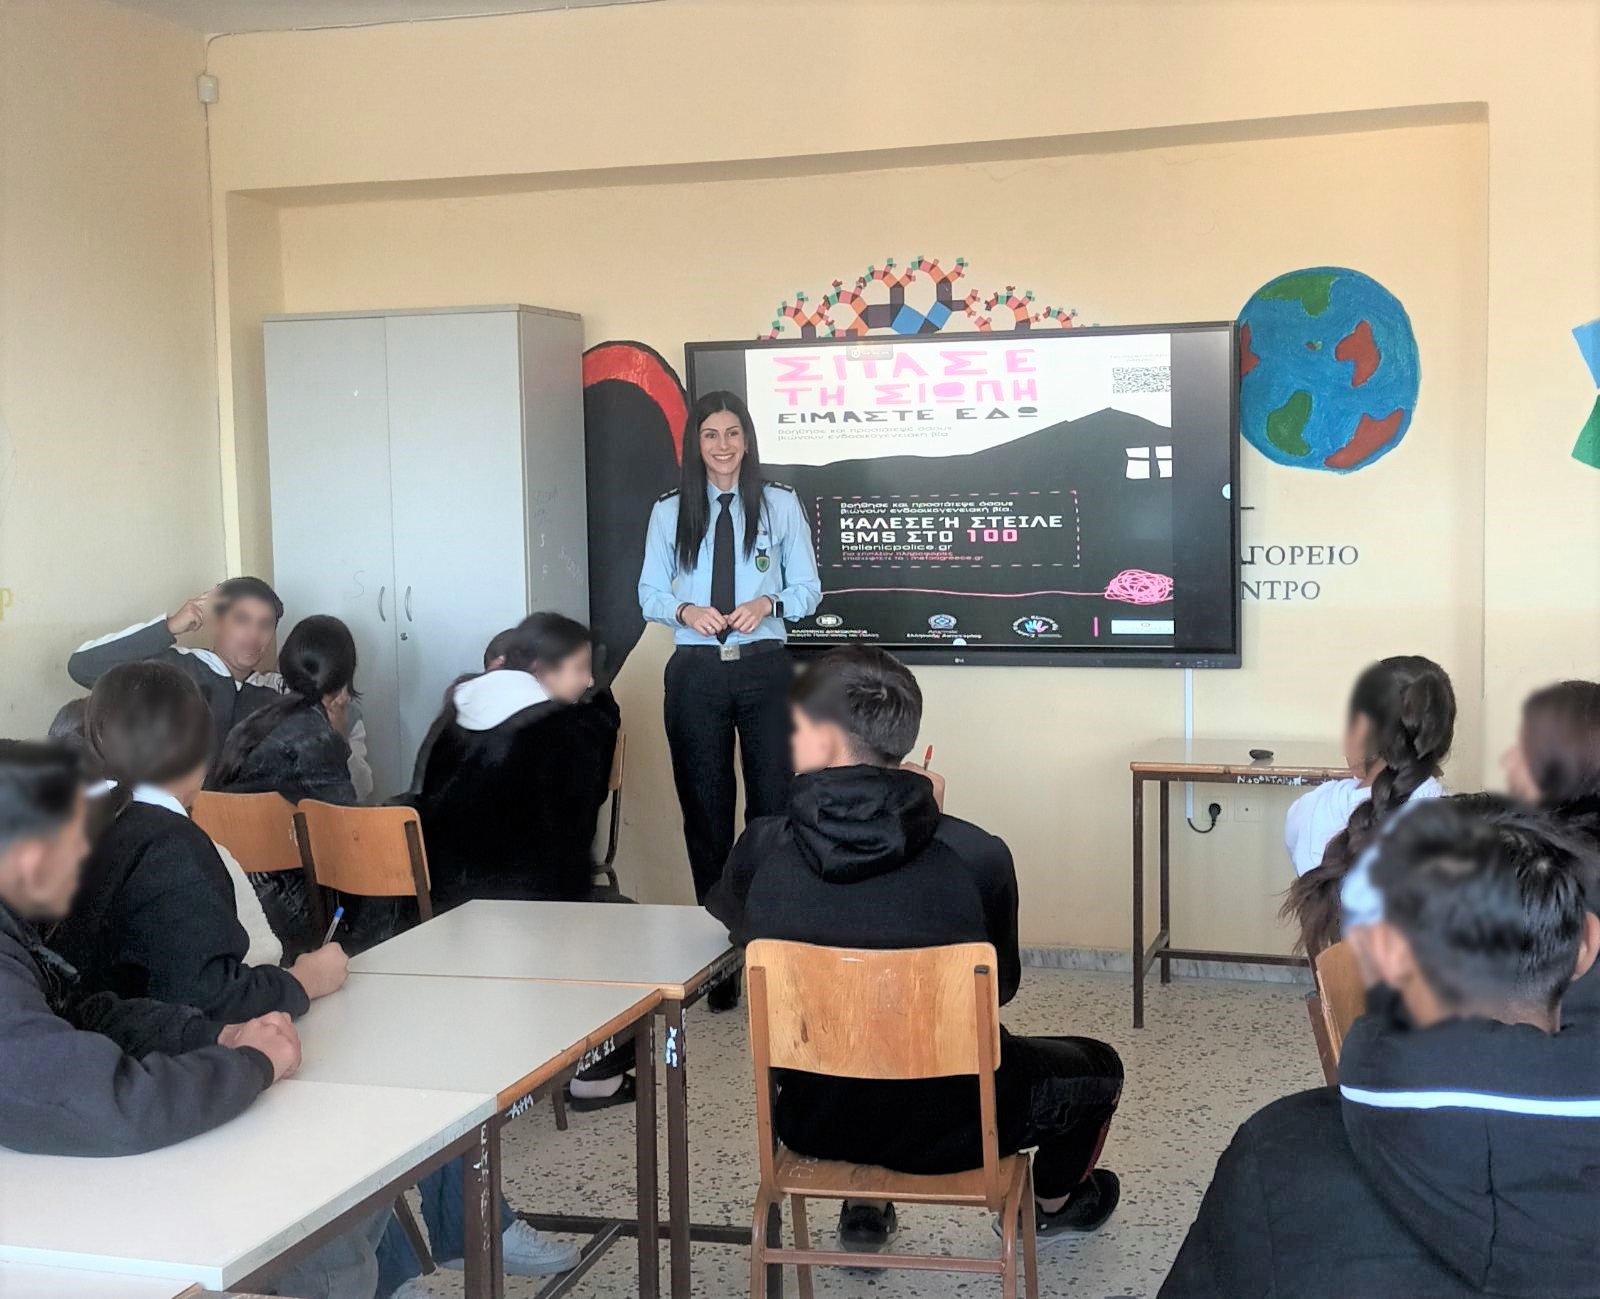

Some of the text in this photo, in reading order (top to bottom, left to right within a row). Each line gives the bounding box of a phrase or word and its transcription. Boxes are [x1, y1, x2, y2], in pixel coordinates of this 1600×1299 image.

[774, 379, 1038, 406] ΤΗ ΣΙΩΠΗ
[778, 407, 1038, 424] ΕΙΜΑΣΤΕ ΕΔΩ
[840, 517, 935, 530] ΚΑΛΕΣΕ
[970, 515, 1063, 529] ΣΤΕΙΛΕ
[841, 529, 1018, 543] SMS ΣΤΟ 100
[841, 544, 953, 552] hellenicpolice.gr
[1241, 545, 1358, 566] ΓΟΡΕΙΟ
